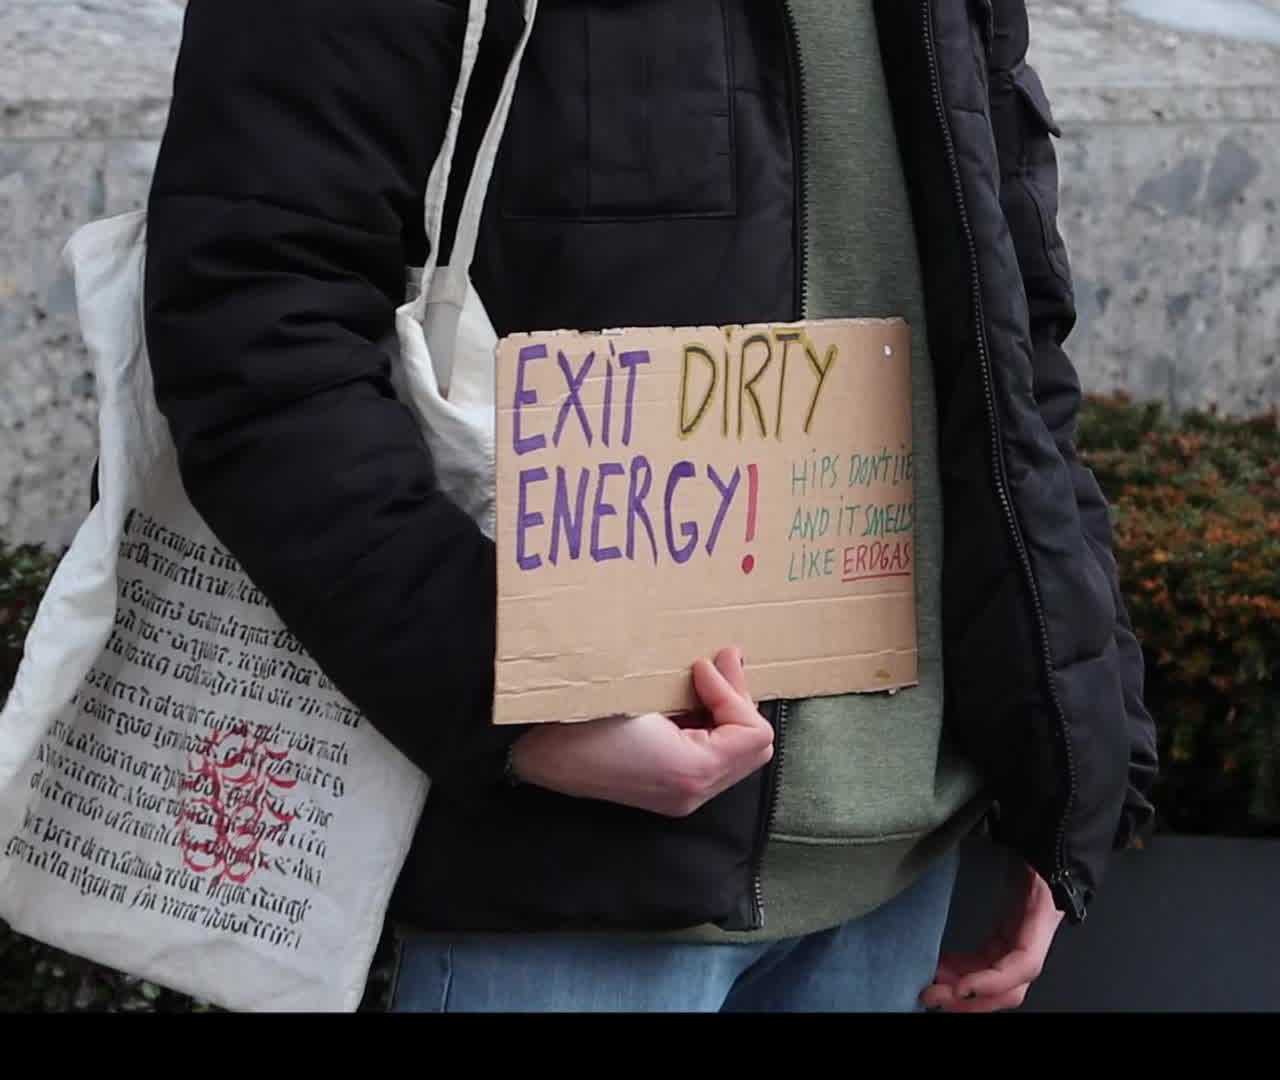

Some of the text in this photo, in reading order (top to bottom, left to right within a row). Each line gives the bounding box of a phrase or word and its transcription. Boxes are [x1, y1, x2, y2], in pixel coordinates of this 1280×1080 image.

[516, 454, 760, 575] ENERGY!
[788, 506, 830, 542] AND
[842, 541, 912, 576] ERDGAS
